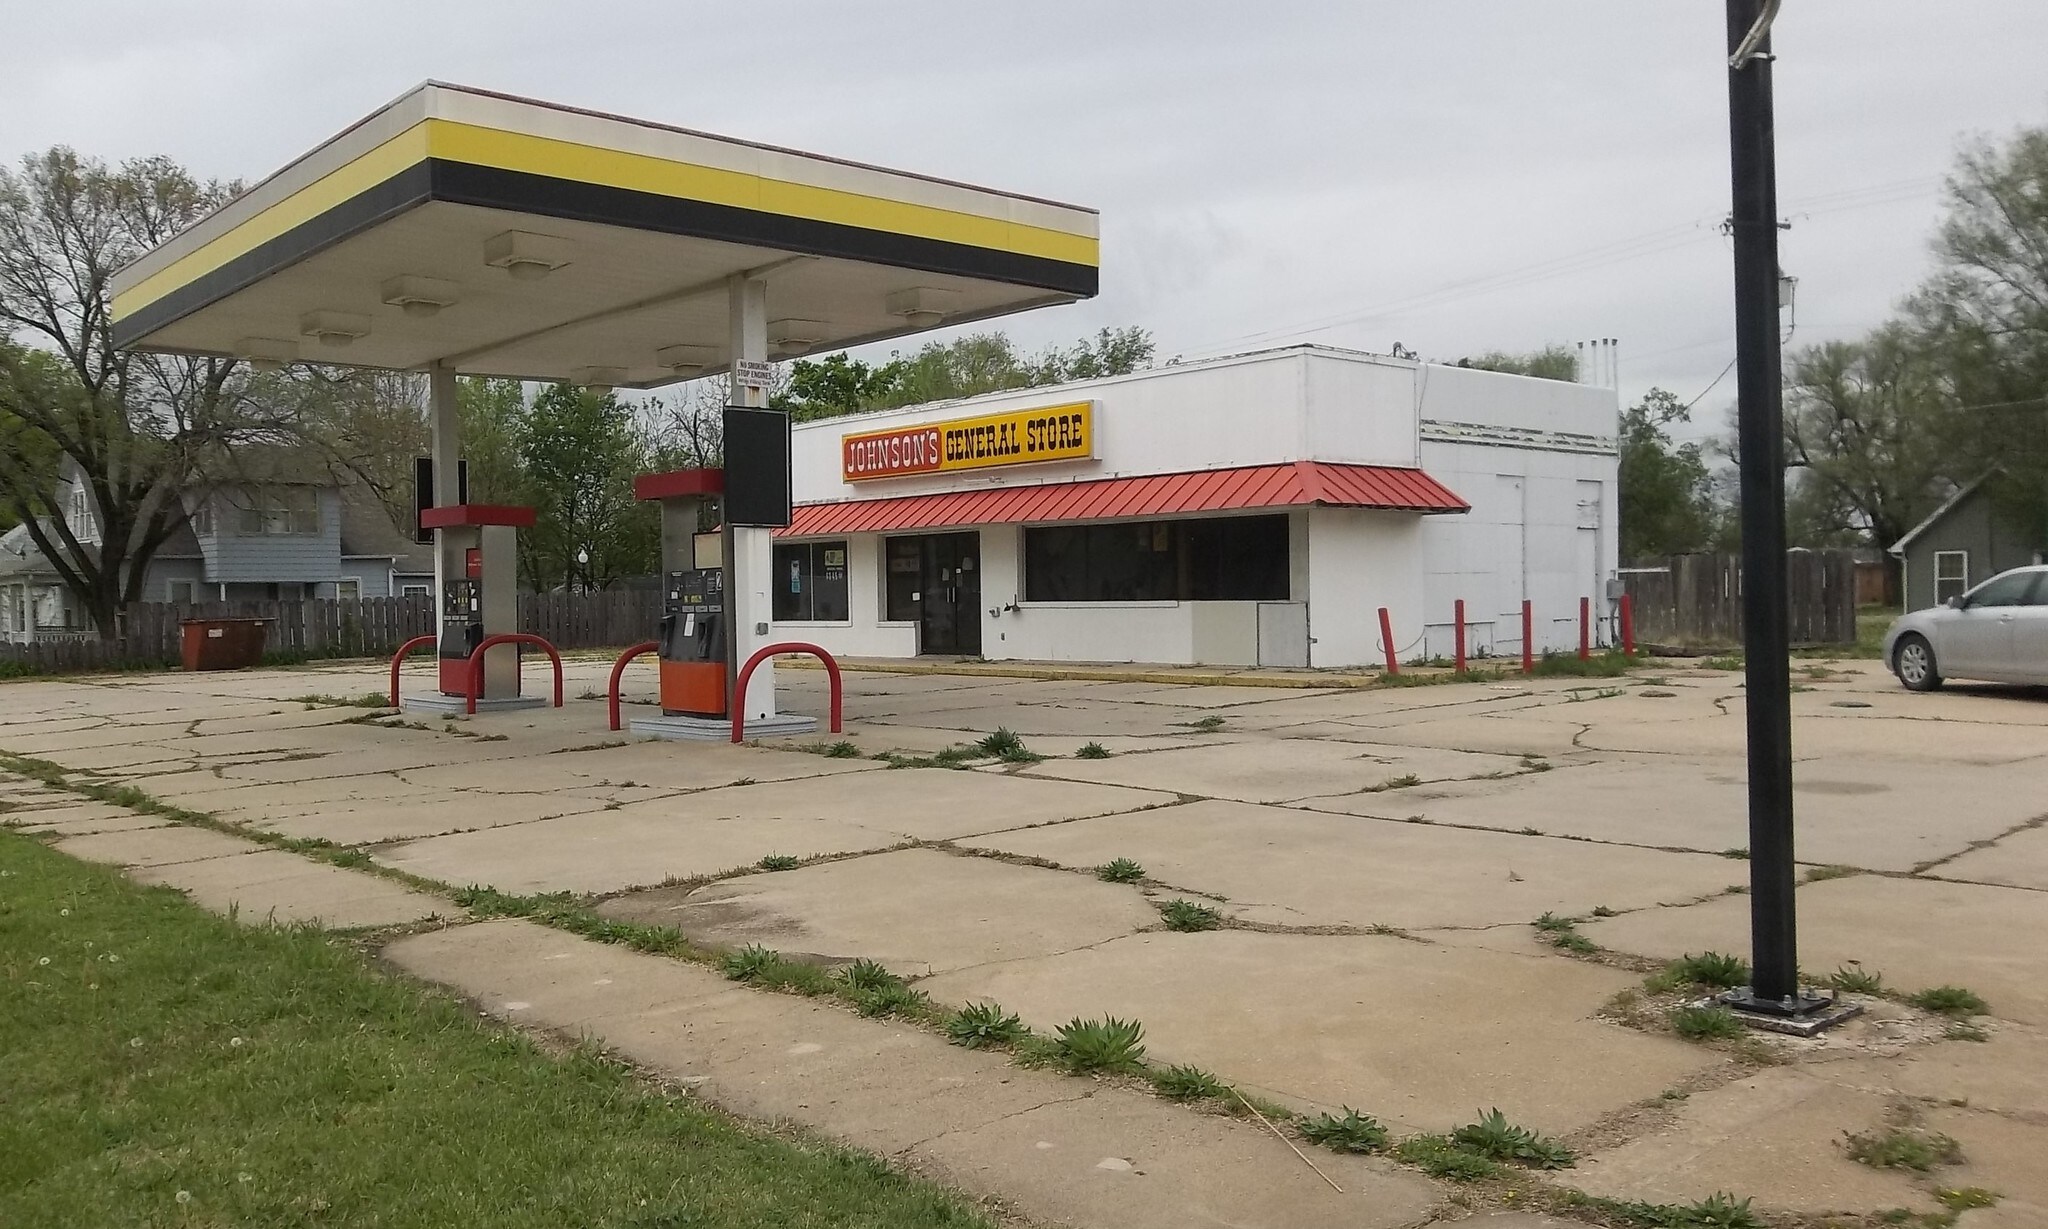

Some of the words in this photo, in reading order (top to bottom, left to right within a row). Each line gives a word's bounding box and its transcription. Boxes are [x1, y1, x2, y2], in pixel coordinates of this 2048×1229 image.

[748, 362, 769, 371] SMOKING
[737, 369, 750, 377] STOP
[751, 371, 771, 379] ENGINES
[847, 430, 939, 473] JOHNSON'S
[945, 422, 1021, 462] GENERAL
[1027, 413, 1083, 452] STORE
